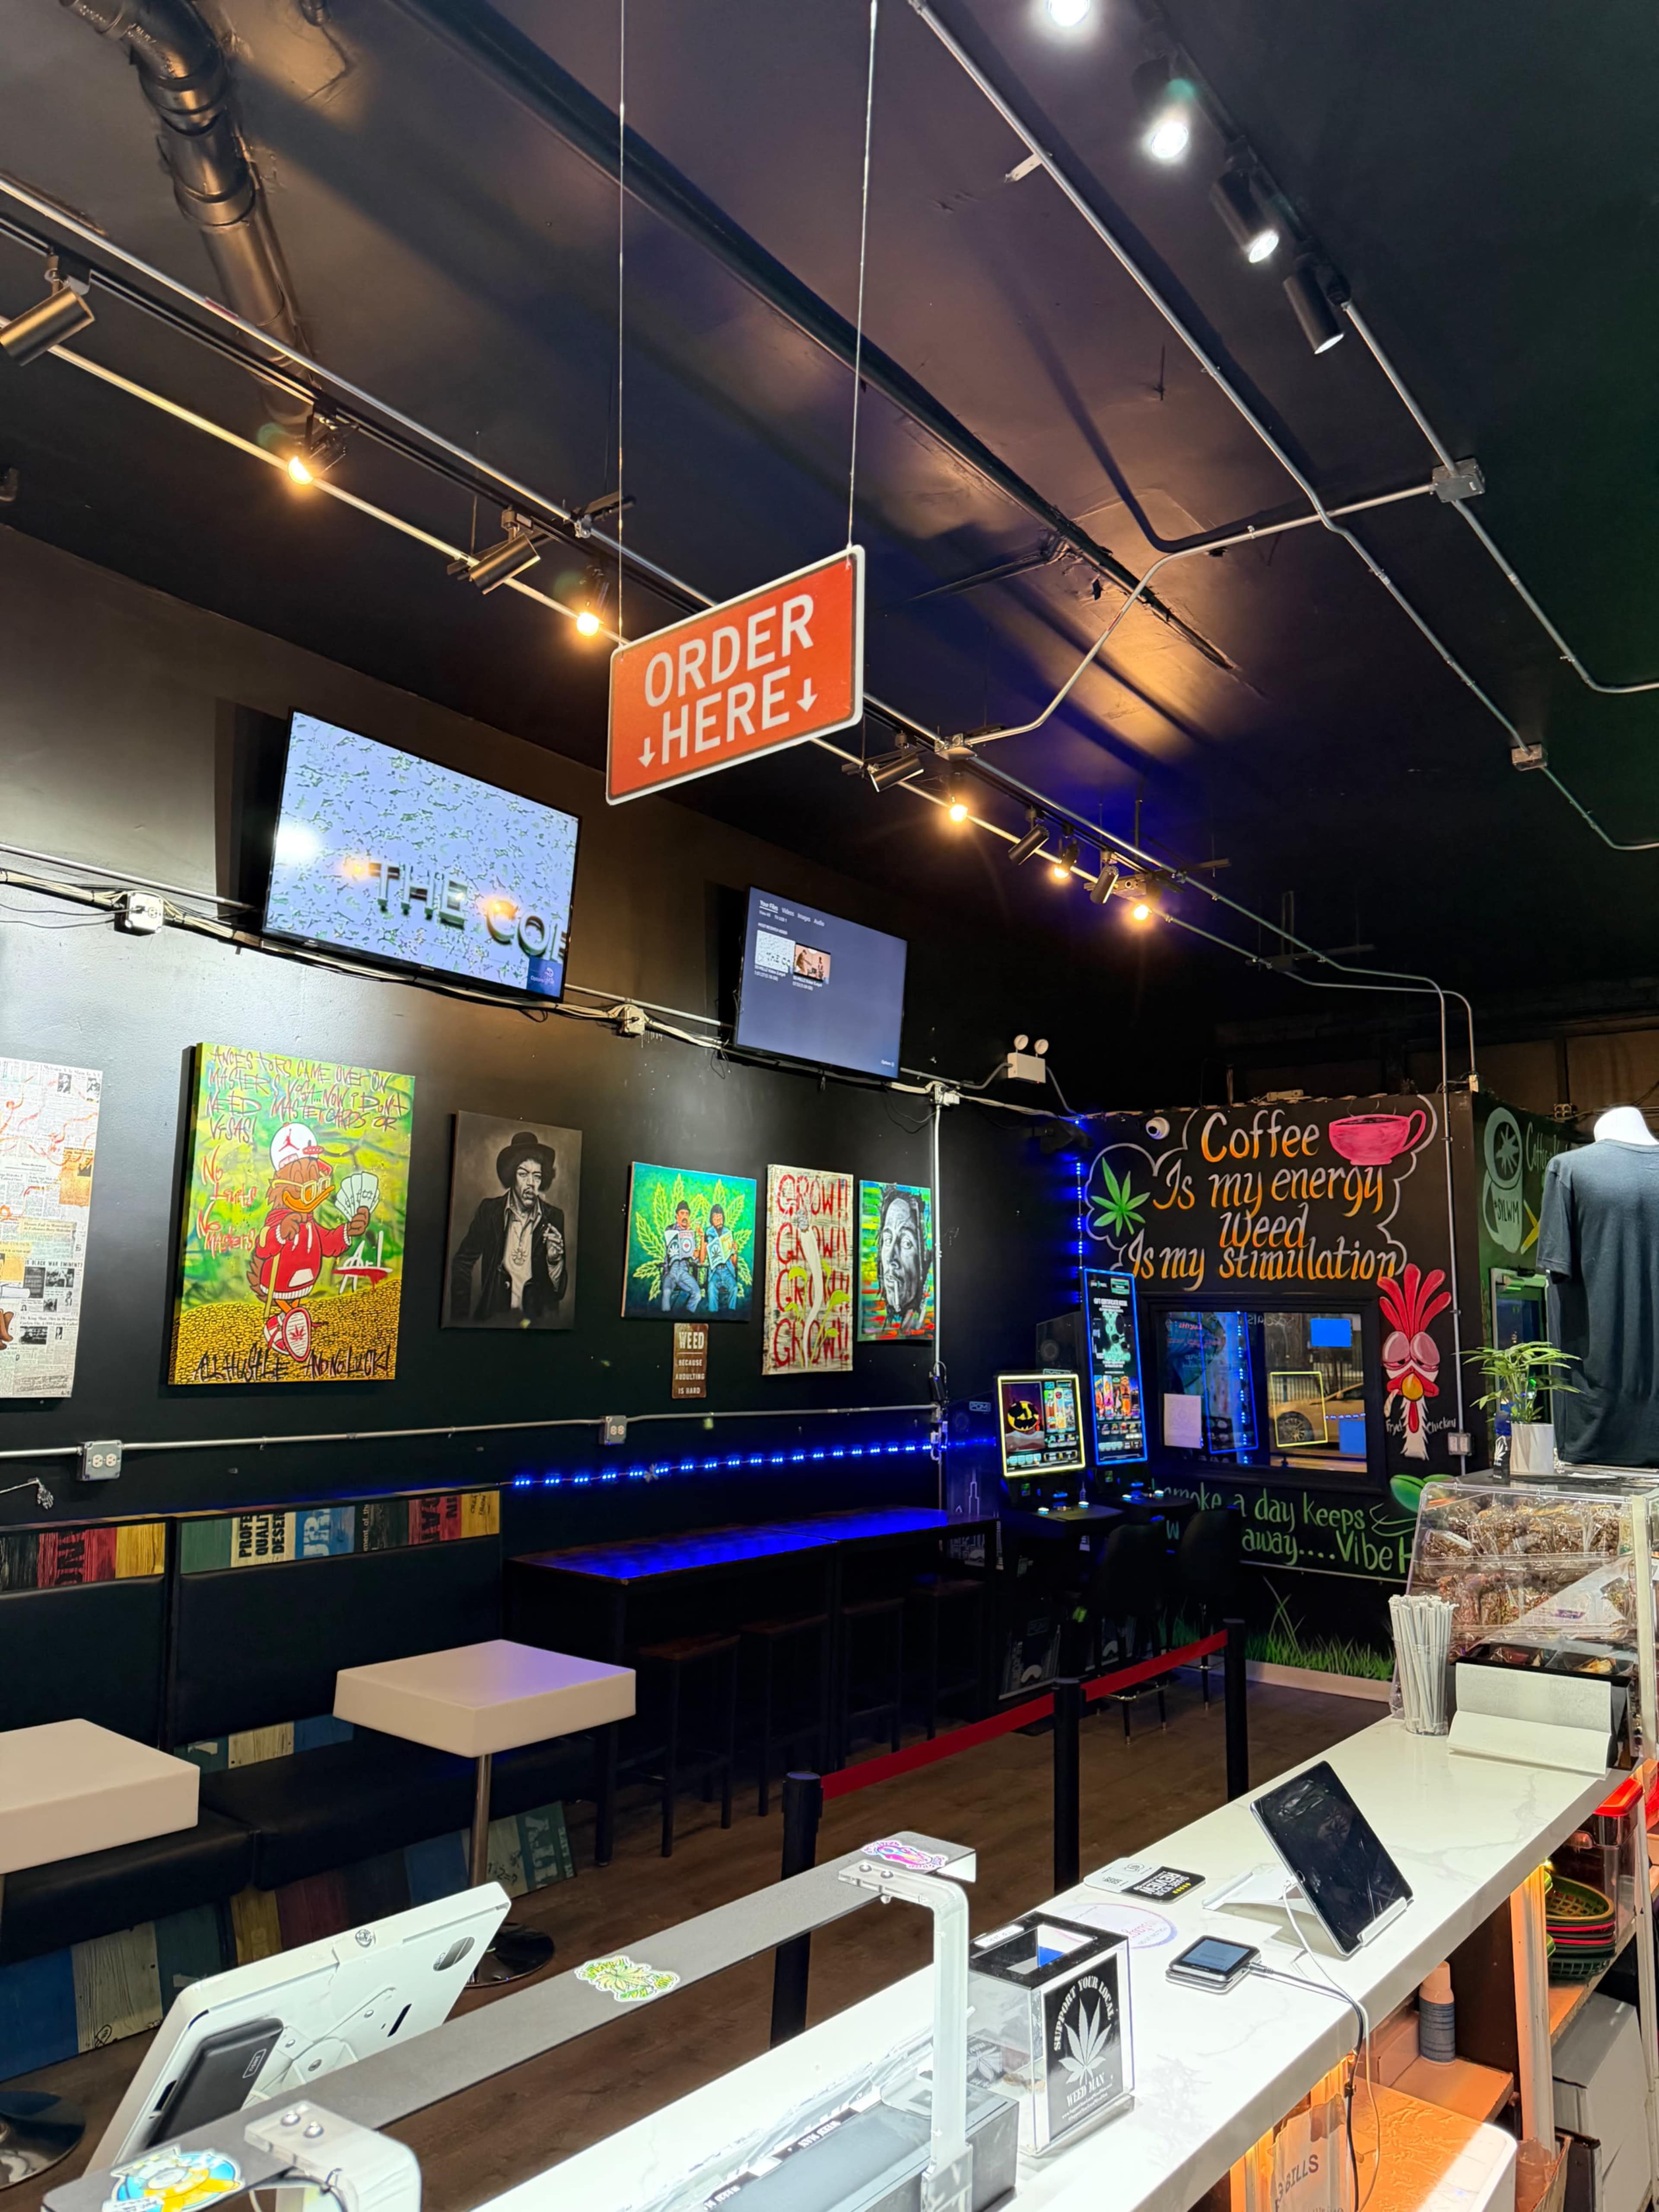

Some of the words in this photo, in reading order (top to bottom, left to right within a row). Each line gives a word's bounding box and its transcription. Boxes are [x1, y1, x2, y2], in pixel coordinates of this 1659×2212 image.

[644, 594, 814, 707] ORDER
[661, 665, 790, 765] HERE
[368, 862, 468, 930] THE
[370, 1072, 392, 1093] ON
[1201, 1109, 1320, 1163] Coffee
[1152, 1159, 1195, 1210] Is
[1208, 1171, 1263, 1220] my
[1271, 1165, 1383, 1217] energy
[1159, 1246, 1205, 1292] my
[679, 1331, 705, 1349] WEED
[1254, 1488, 1295, 1532] day
[1303, 1491, 1365, 1535] keeps
[1139, 1871, 1182, 1895] REVIEW
[1053, 1984, 1077, 2051] SUPPORT
[1077, 1975, 1099, 1992] YOUR
[1099, 1980, 1115, 2020] LOCAL
[1066, 2084, 1087, 2107] WEED
[1088, 2072, 1105, 2093] MAN
